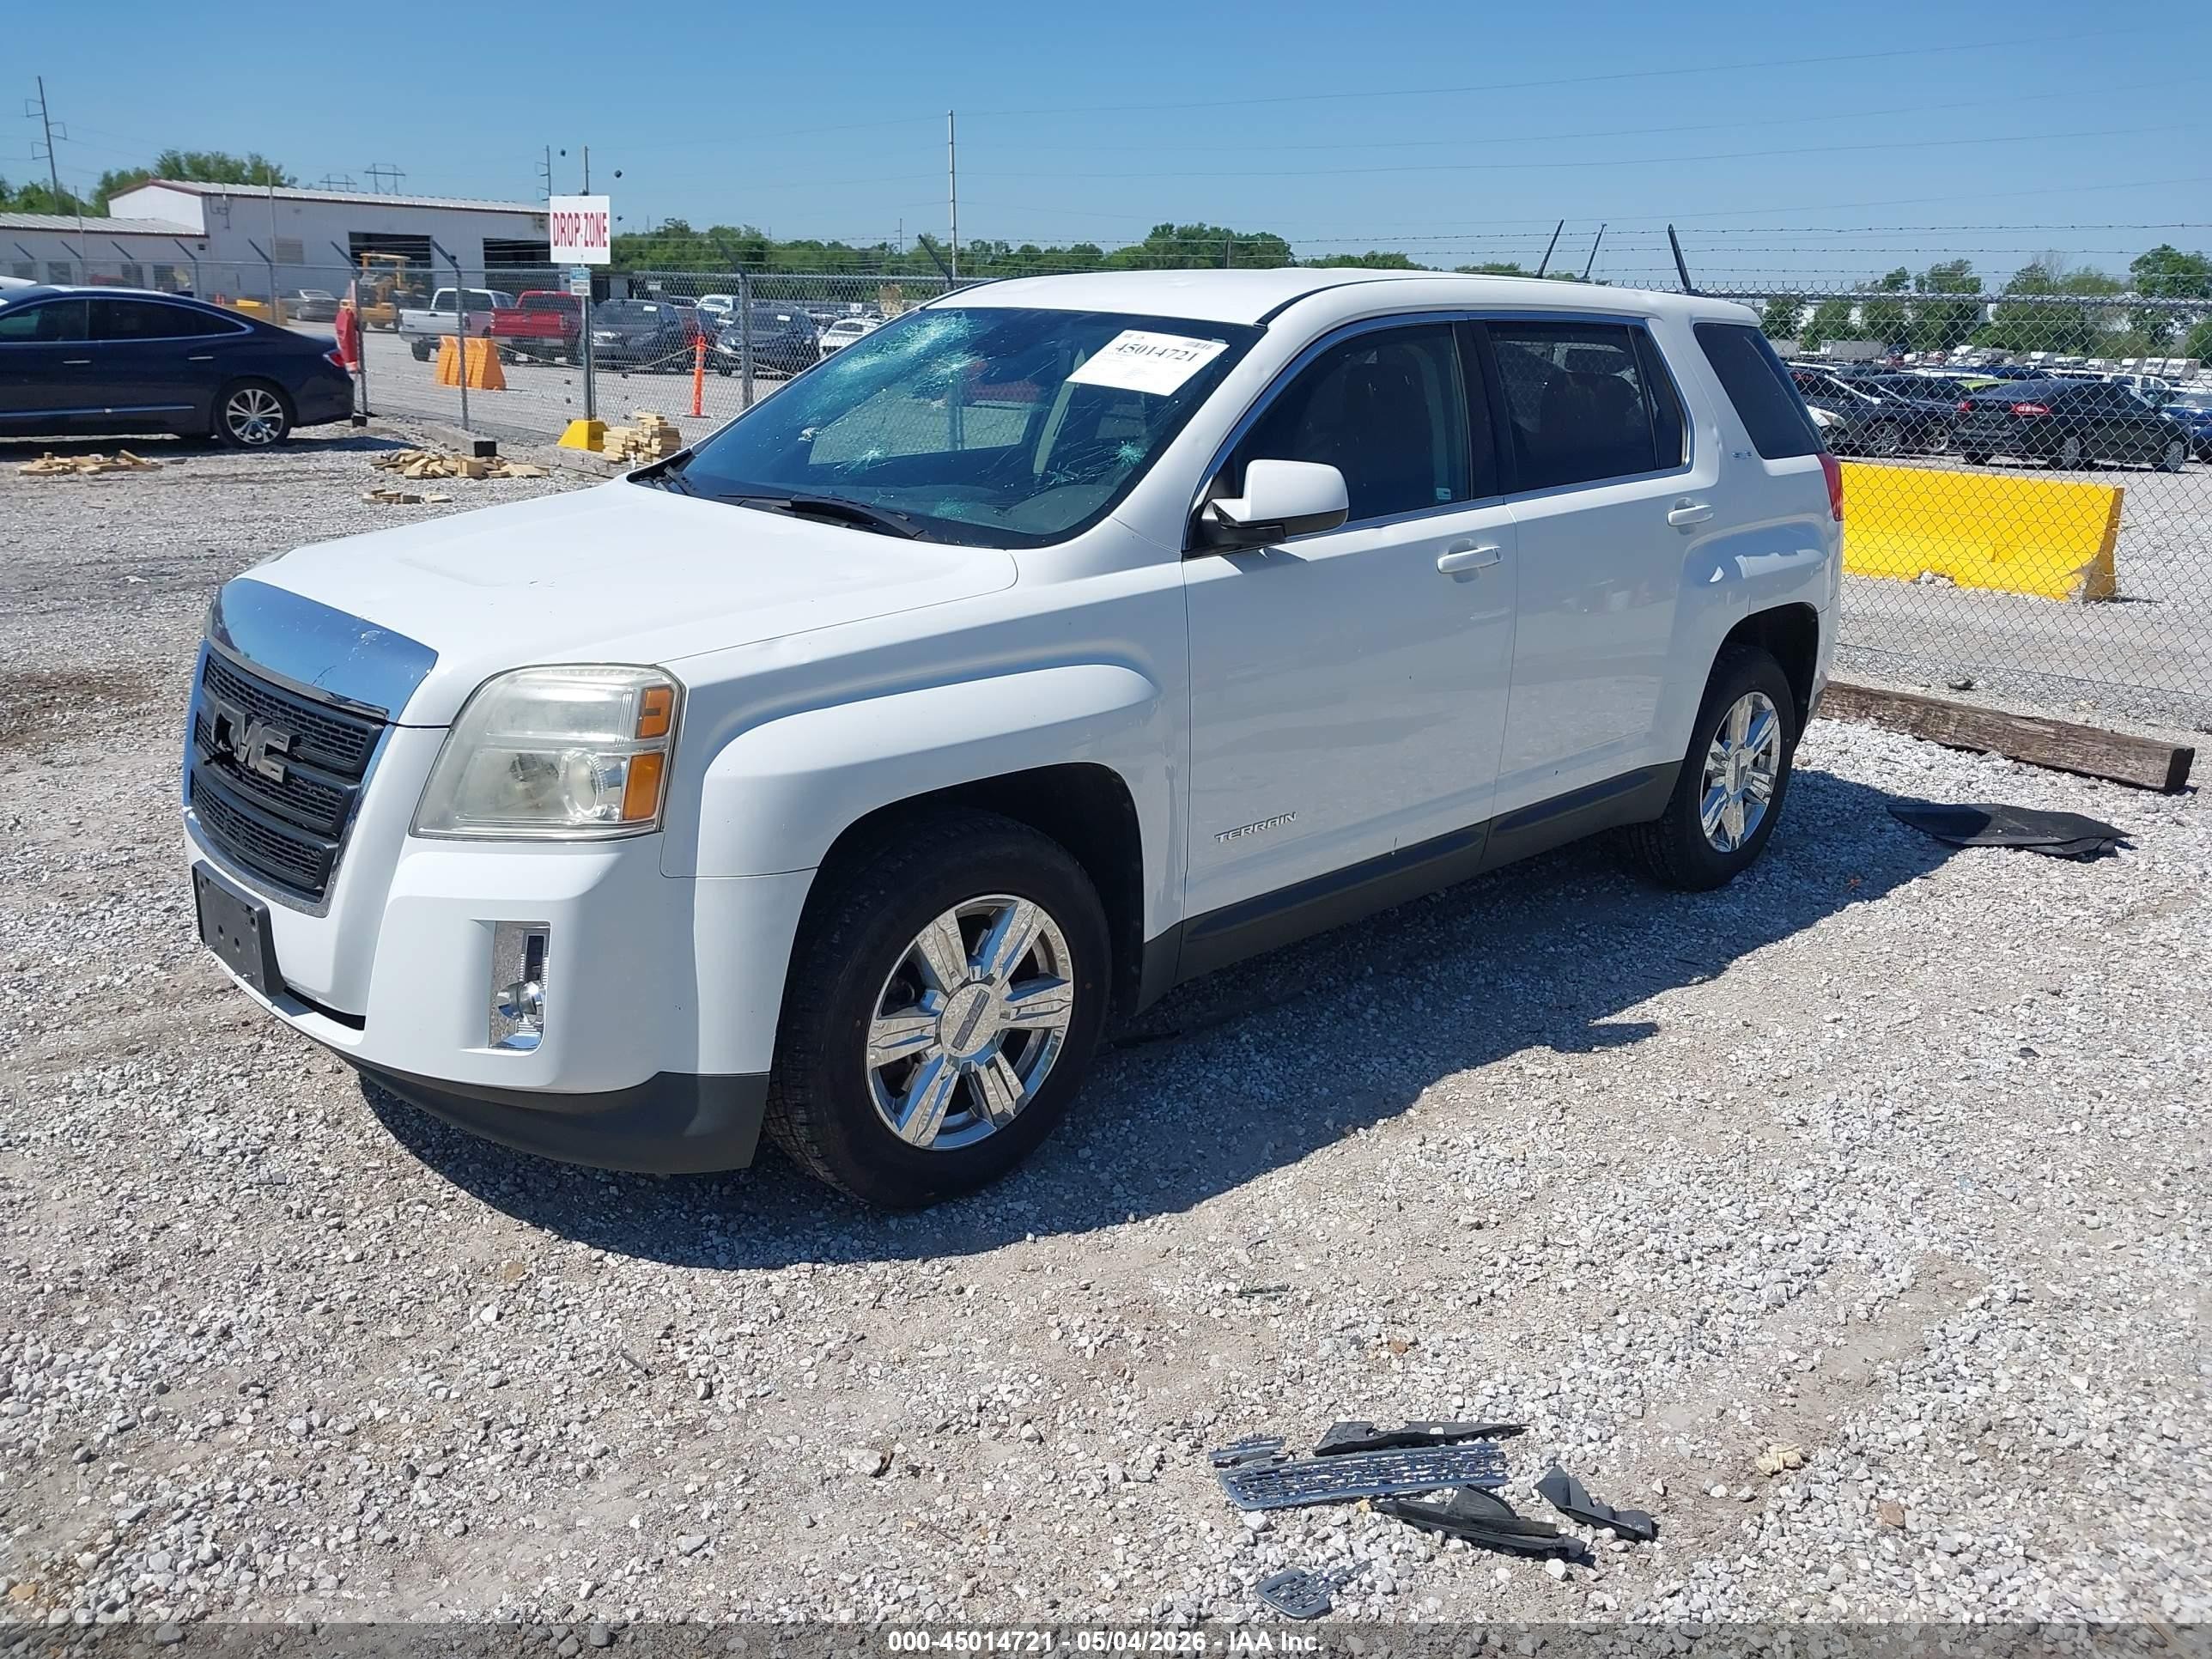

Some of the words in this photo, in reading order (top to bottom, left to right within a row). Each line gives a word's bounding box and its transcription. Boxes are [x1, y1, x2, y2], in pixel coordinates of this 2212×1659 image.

[553, 212, 580, 248] DROP
[584, 212, 607, 248] ZONE
[1115, 343, 1199, 362] 45014721
[1214, 811, 1297, 843] TERRAIN
